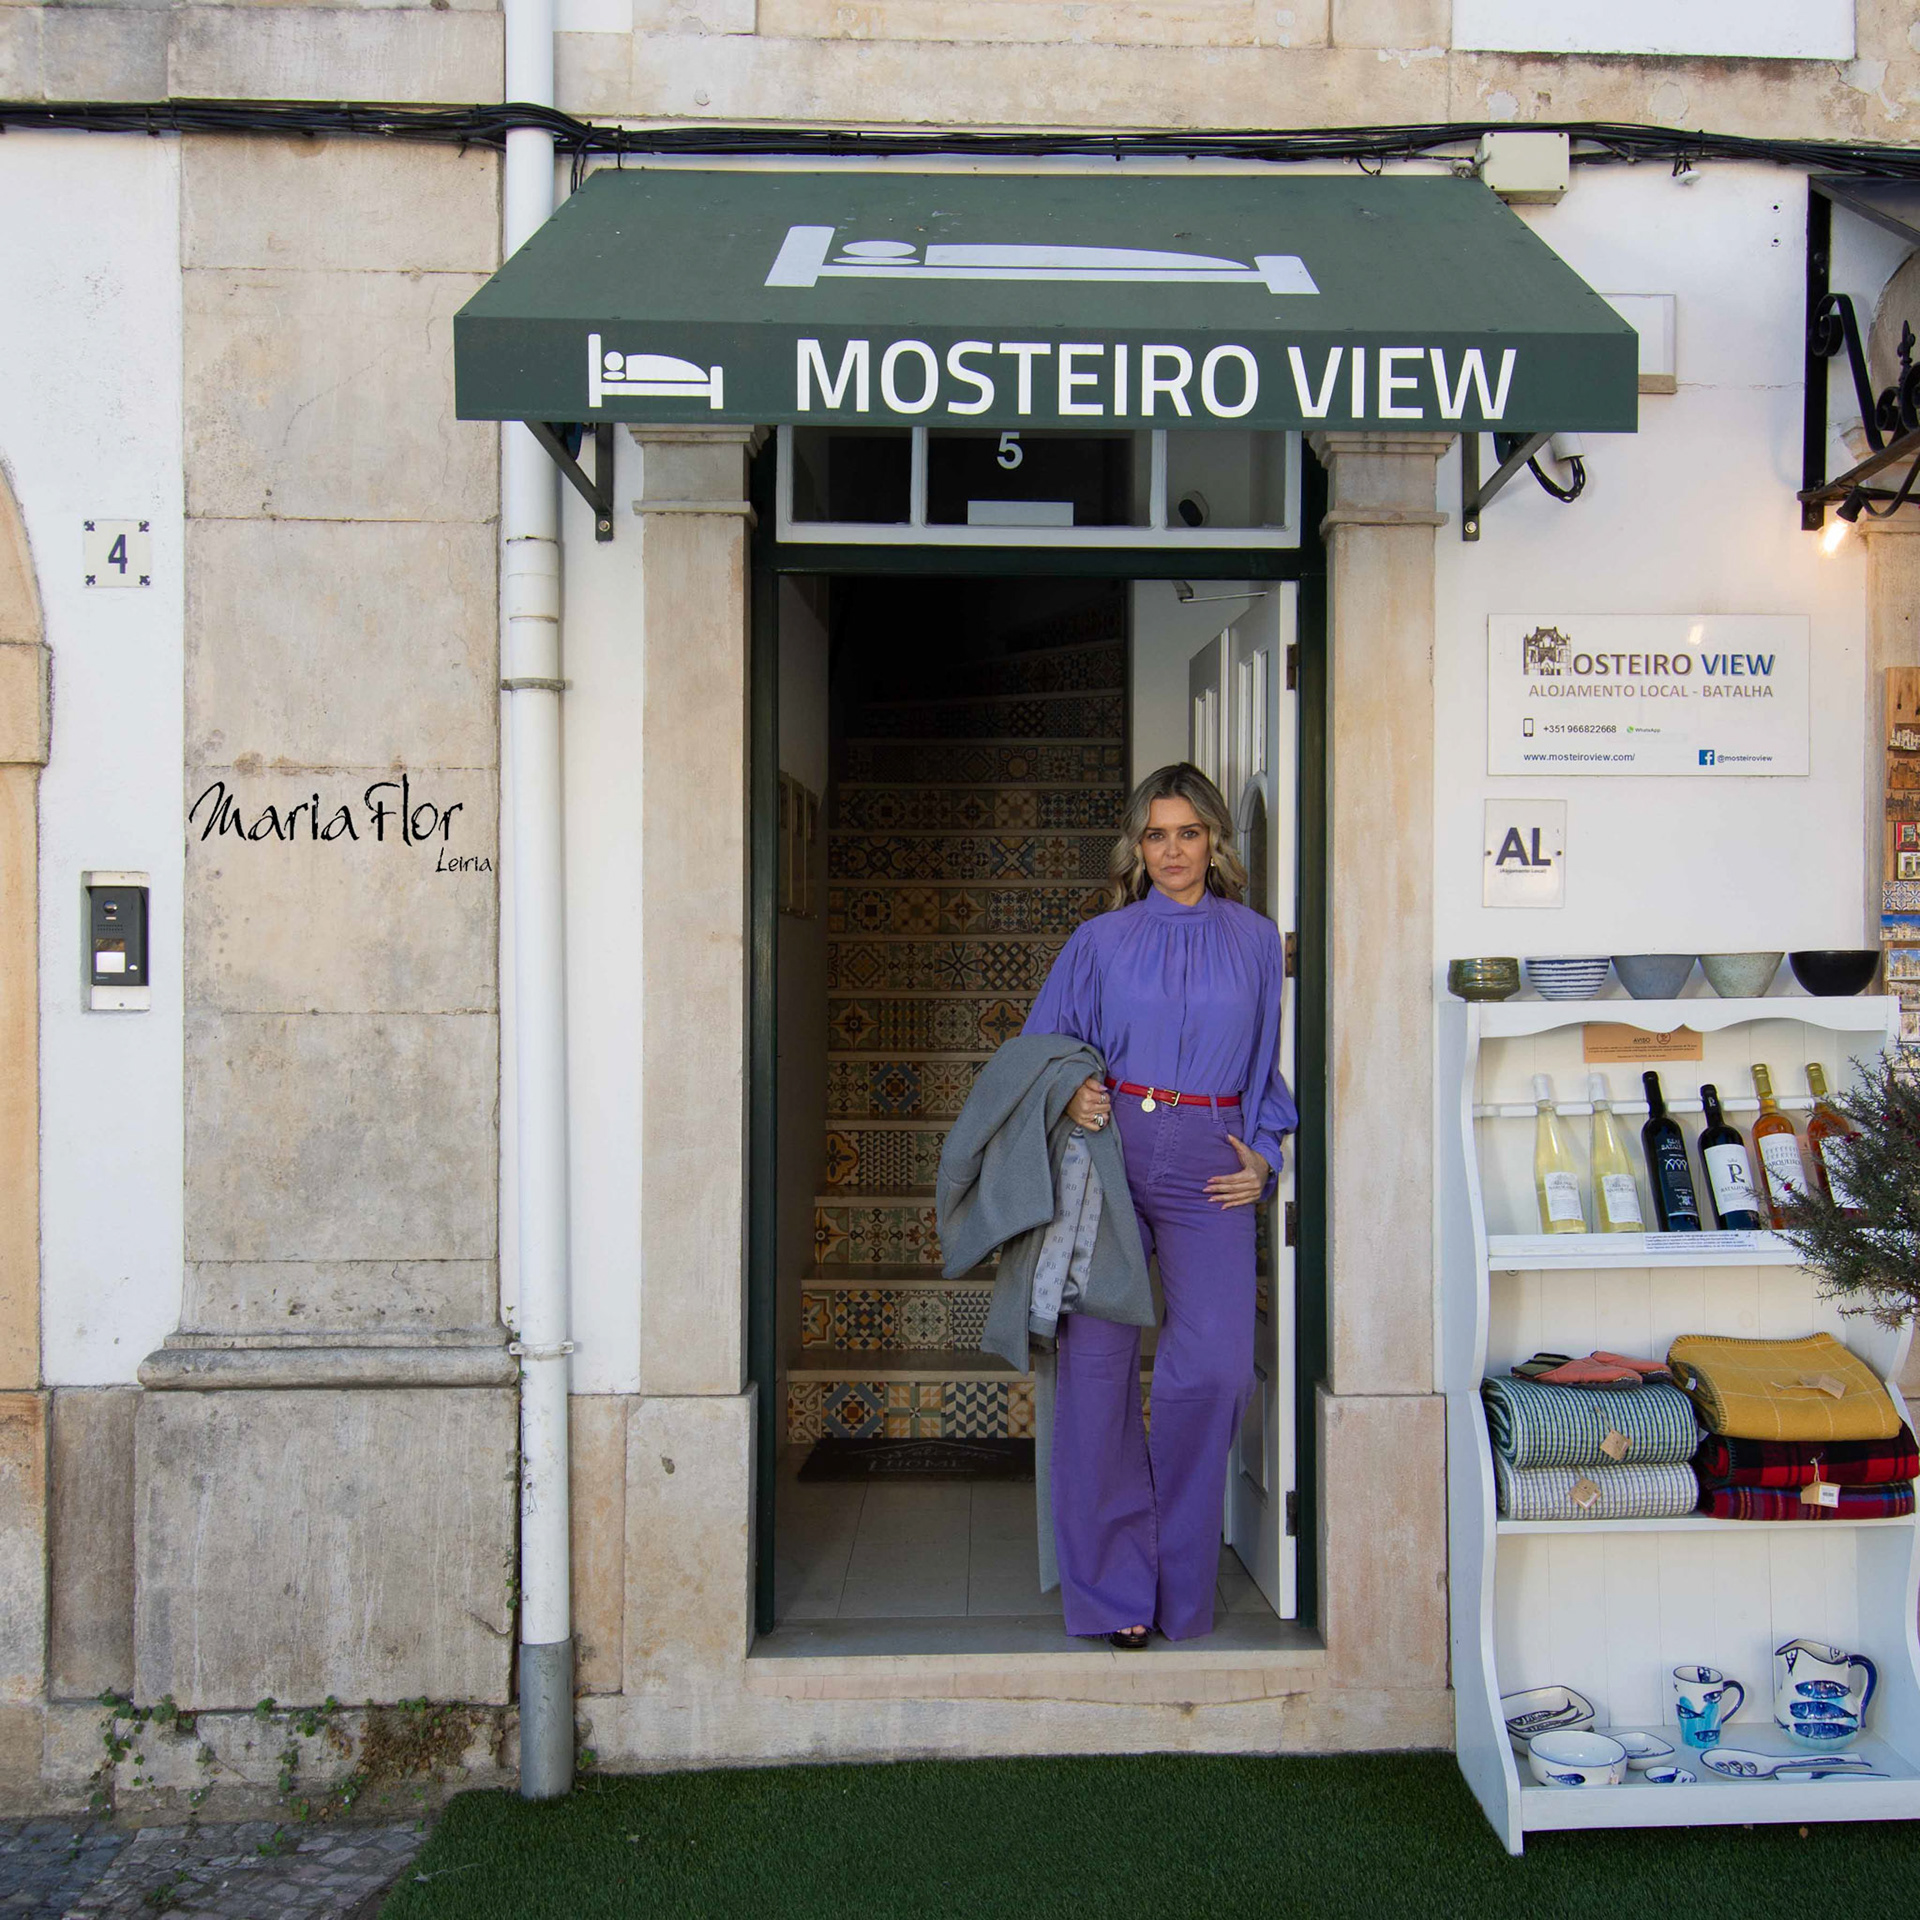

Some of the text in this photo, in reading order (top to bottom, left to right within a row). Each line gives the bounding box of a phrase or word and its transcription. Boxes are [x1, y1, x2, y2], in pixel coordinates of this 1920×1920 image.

[796, 339, 1517, 420] MOSTEIRO VIEW
[997, 432, 1023, 470] 5
[108, 534, 128, 574] 4
[1701, 653, 1776, 677] VIEW
[1528, 684, 1635, 698] ALOJAMENTO
[1640, 684, 1688, 698] LOCAL
[1702, 684, 1774, 698] BATALHA
[1543, 724, 1617, 734] +351 966822668
[1523, 752, 1636, 762] www.mosteiroview.com/
[1716, 754, 1773, 764] @mosteiroview
[1495, 827, 1552, 866] AL
[1728, 1163, 1745, 1184] R
